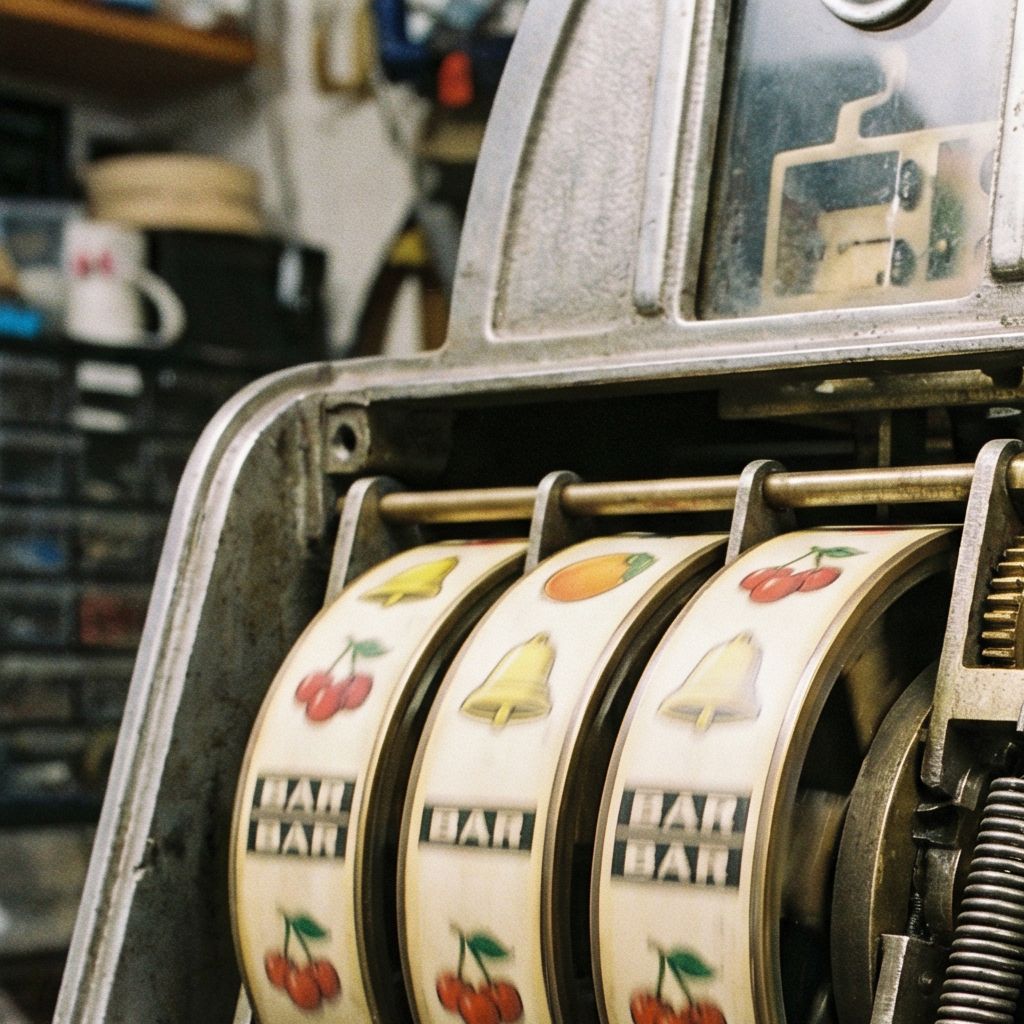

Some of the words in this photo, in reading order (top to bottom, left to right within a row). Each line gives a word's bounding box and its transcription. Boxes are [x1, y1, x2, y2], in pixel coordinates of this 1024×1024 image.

[260, 777, 345, 815] BAR
[629, 788, 738, 835] BAR
[255, 818, 339, 858] BAR
[428, 805, 523, 850] BAR
[623, 839, 729, 886] BAR
